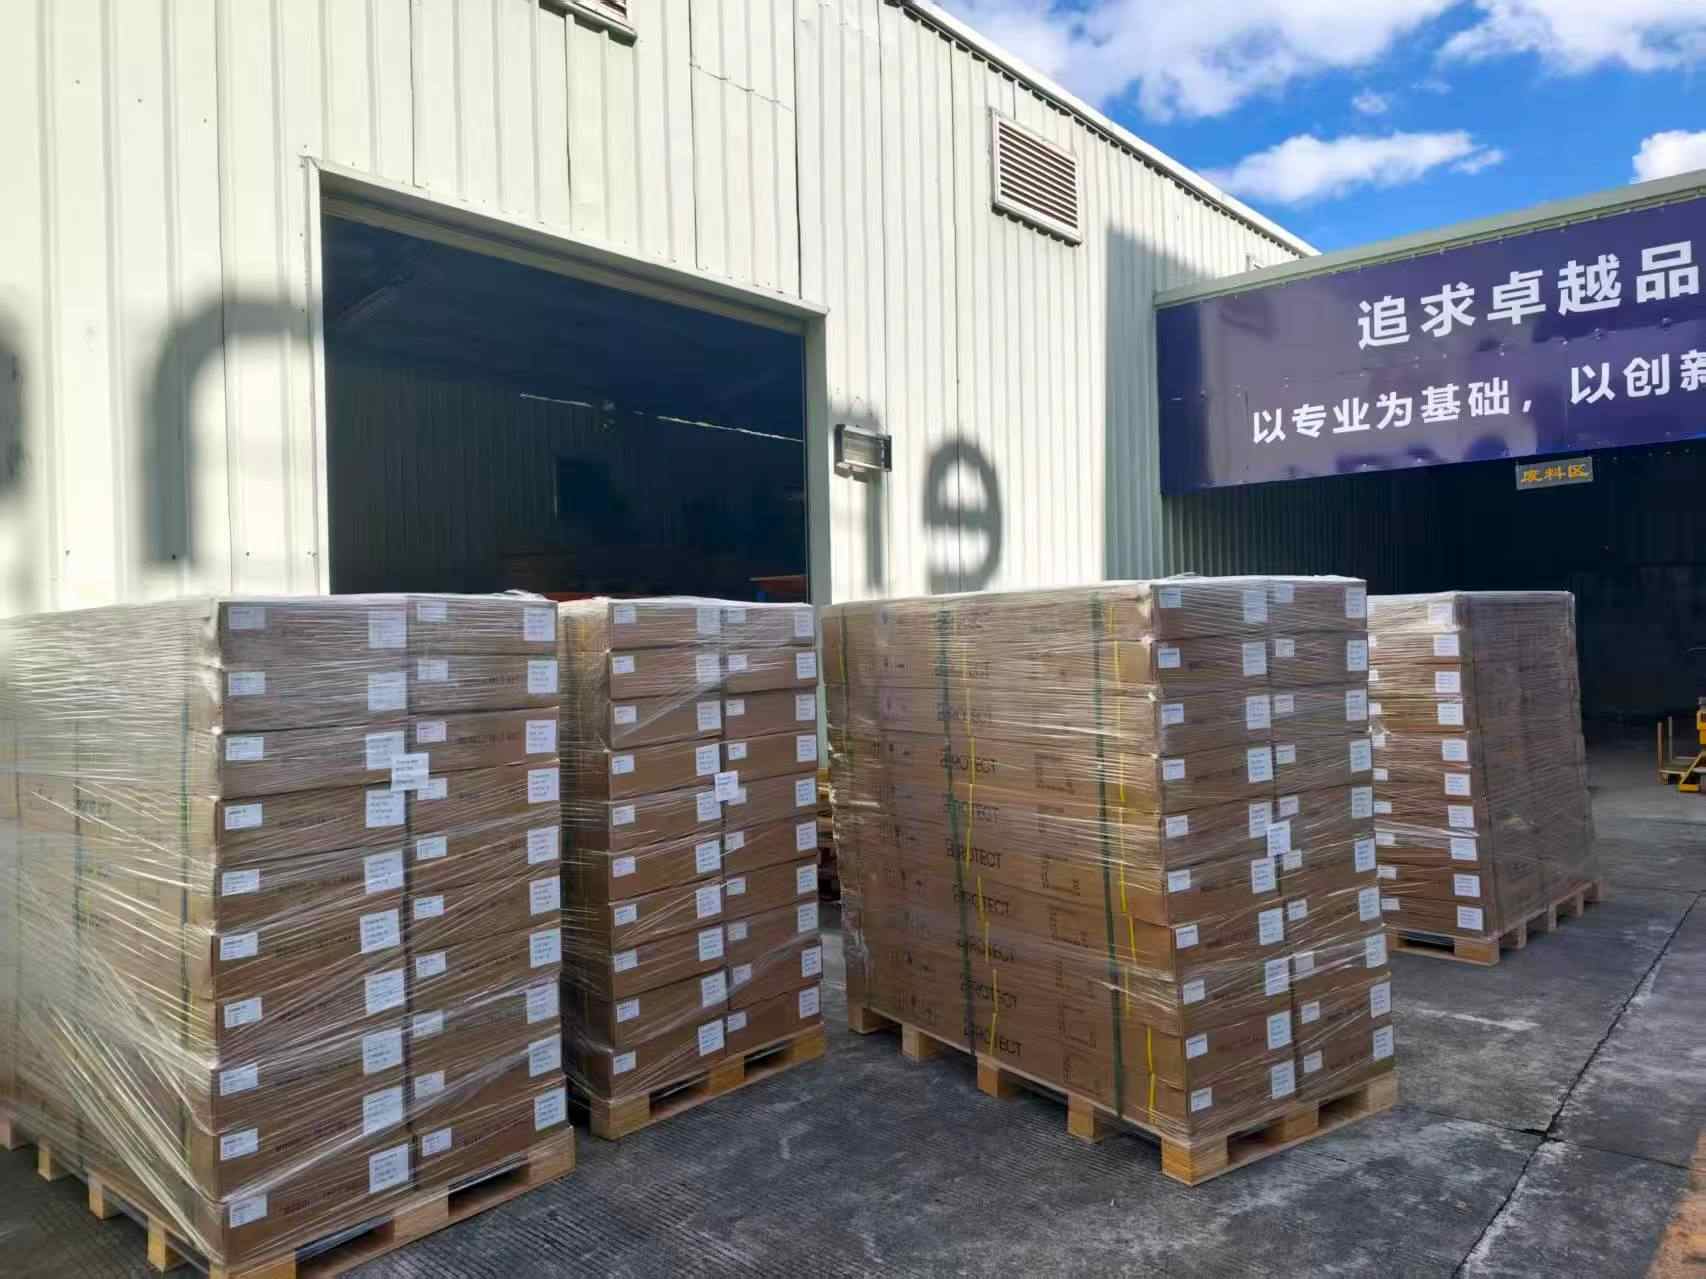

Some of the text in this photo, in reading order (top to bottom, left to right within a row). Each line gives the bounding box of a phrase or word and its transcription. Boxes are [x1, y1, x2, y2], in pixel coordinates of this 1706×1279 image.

[1357, 240, 1699, 350] 追求卓越品
